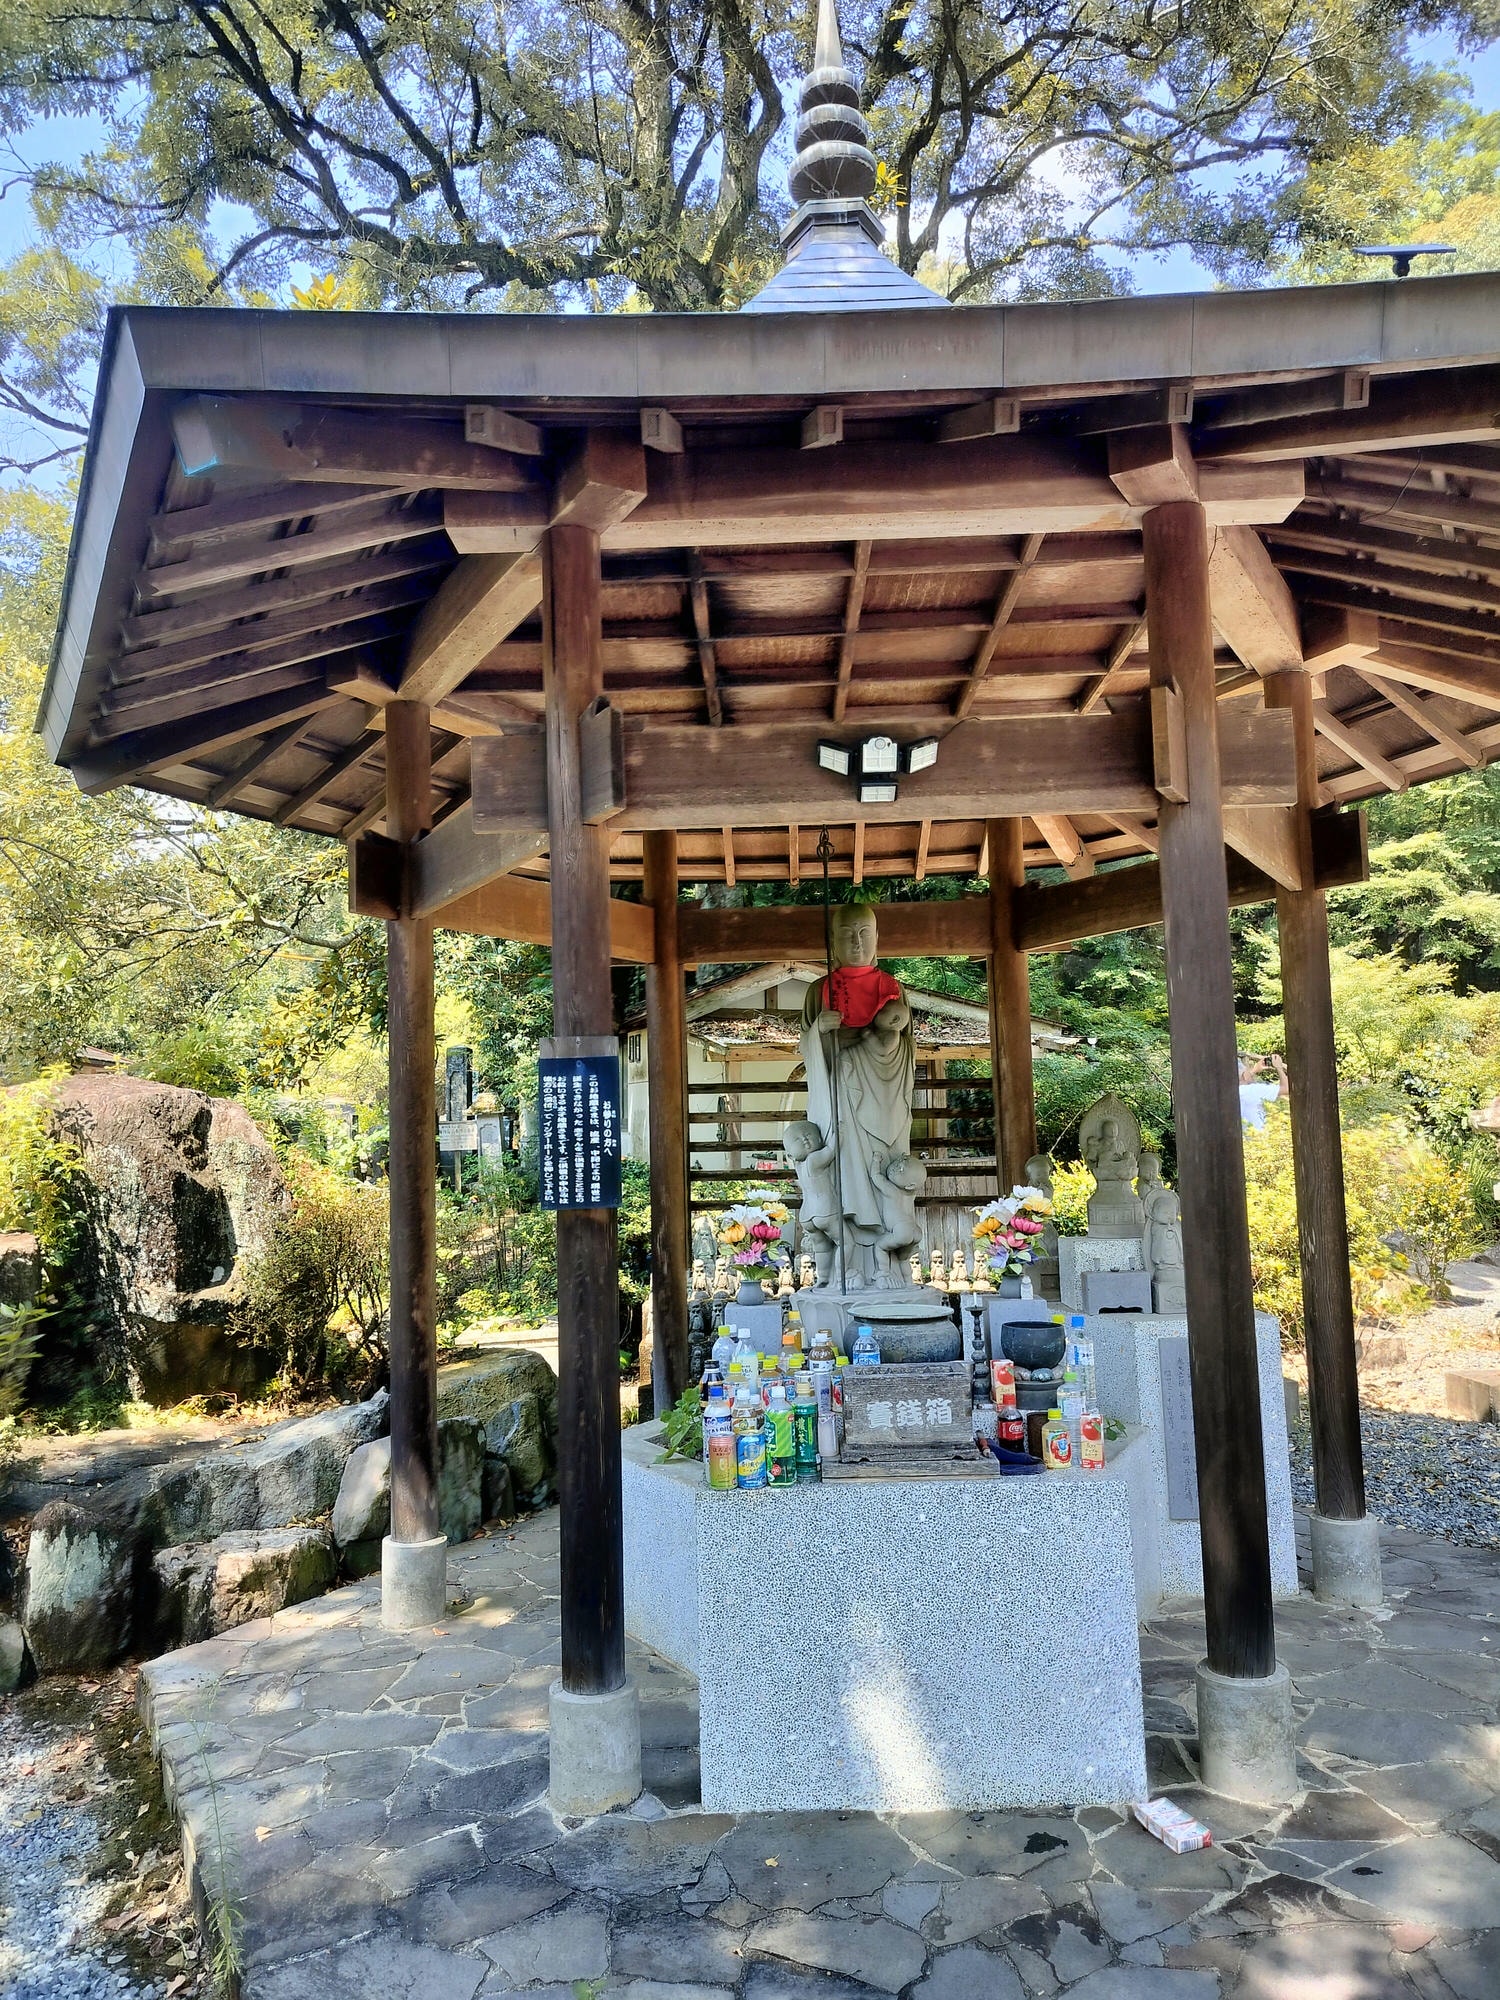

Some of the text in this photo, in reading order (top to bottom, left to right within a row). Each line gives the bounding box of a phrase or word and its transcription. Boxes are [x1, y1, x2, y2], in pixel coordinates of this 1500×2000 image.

[603, 1101, 612, 1156] お参りの方へ
